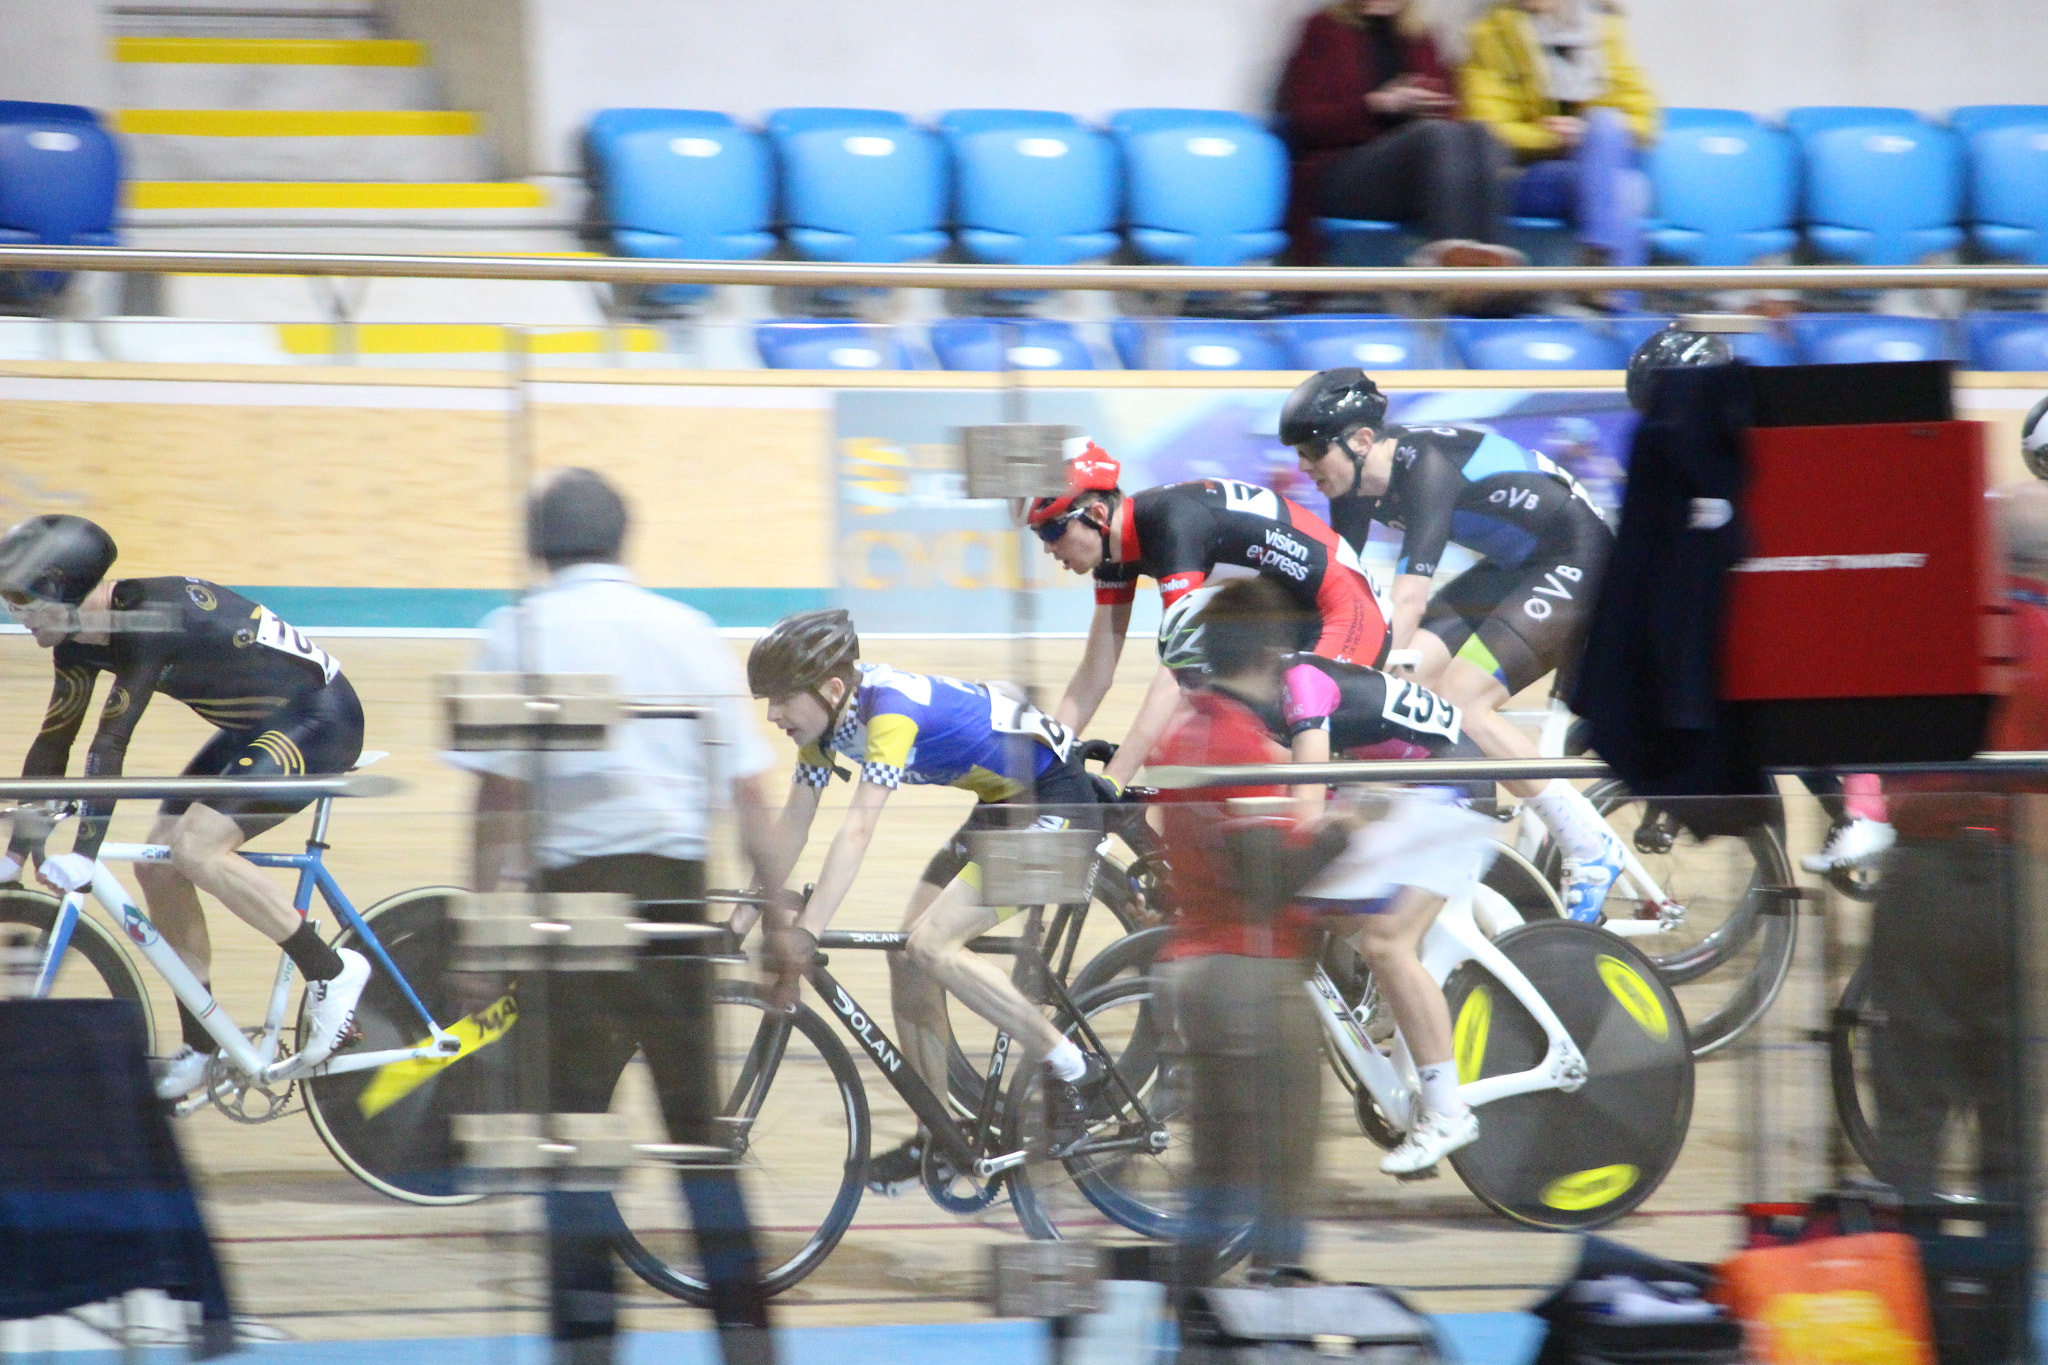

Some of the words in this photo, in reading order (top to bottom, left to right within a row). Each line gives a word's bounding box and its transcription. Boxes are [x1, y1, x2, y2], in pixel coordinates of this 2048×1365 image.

[1246, 544, 1309, 581] express
[1265, 527, 1309, 562] vision
[1391, 681, 1455, 729] 259
[851, 932, 900, 943] DOLAN
[832, 984, 902, 1073] DOLAN
